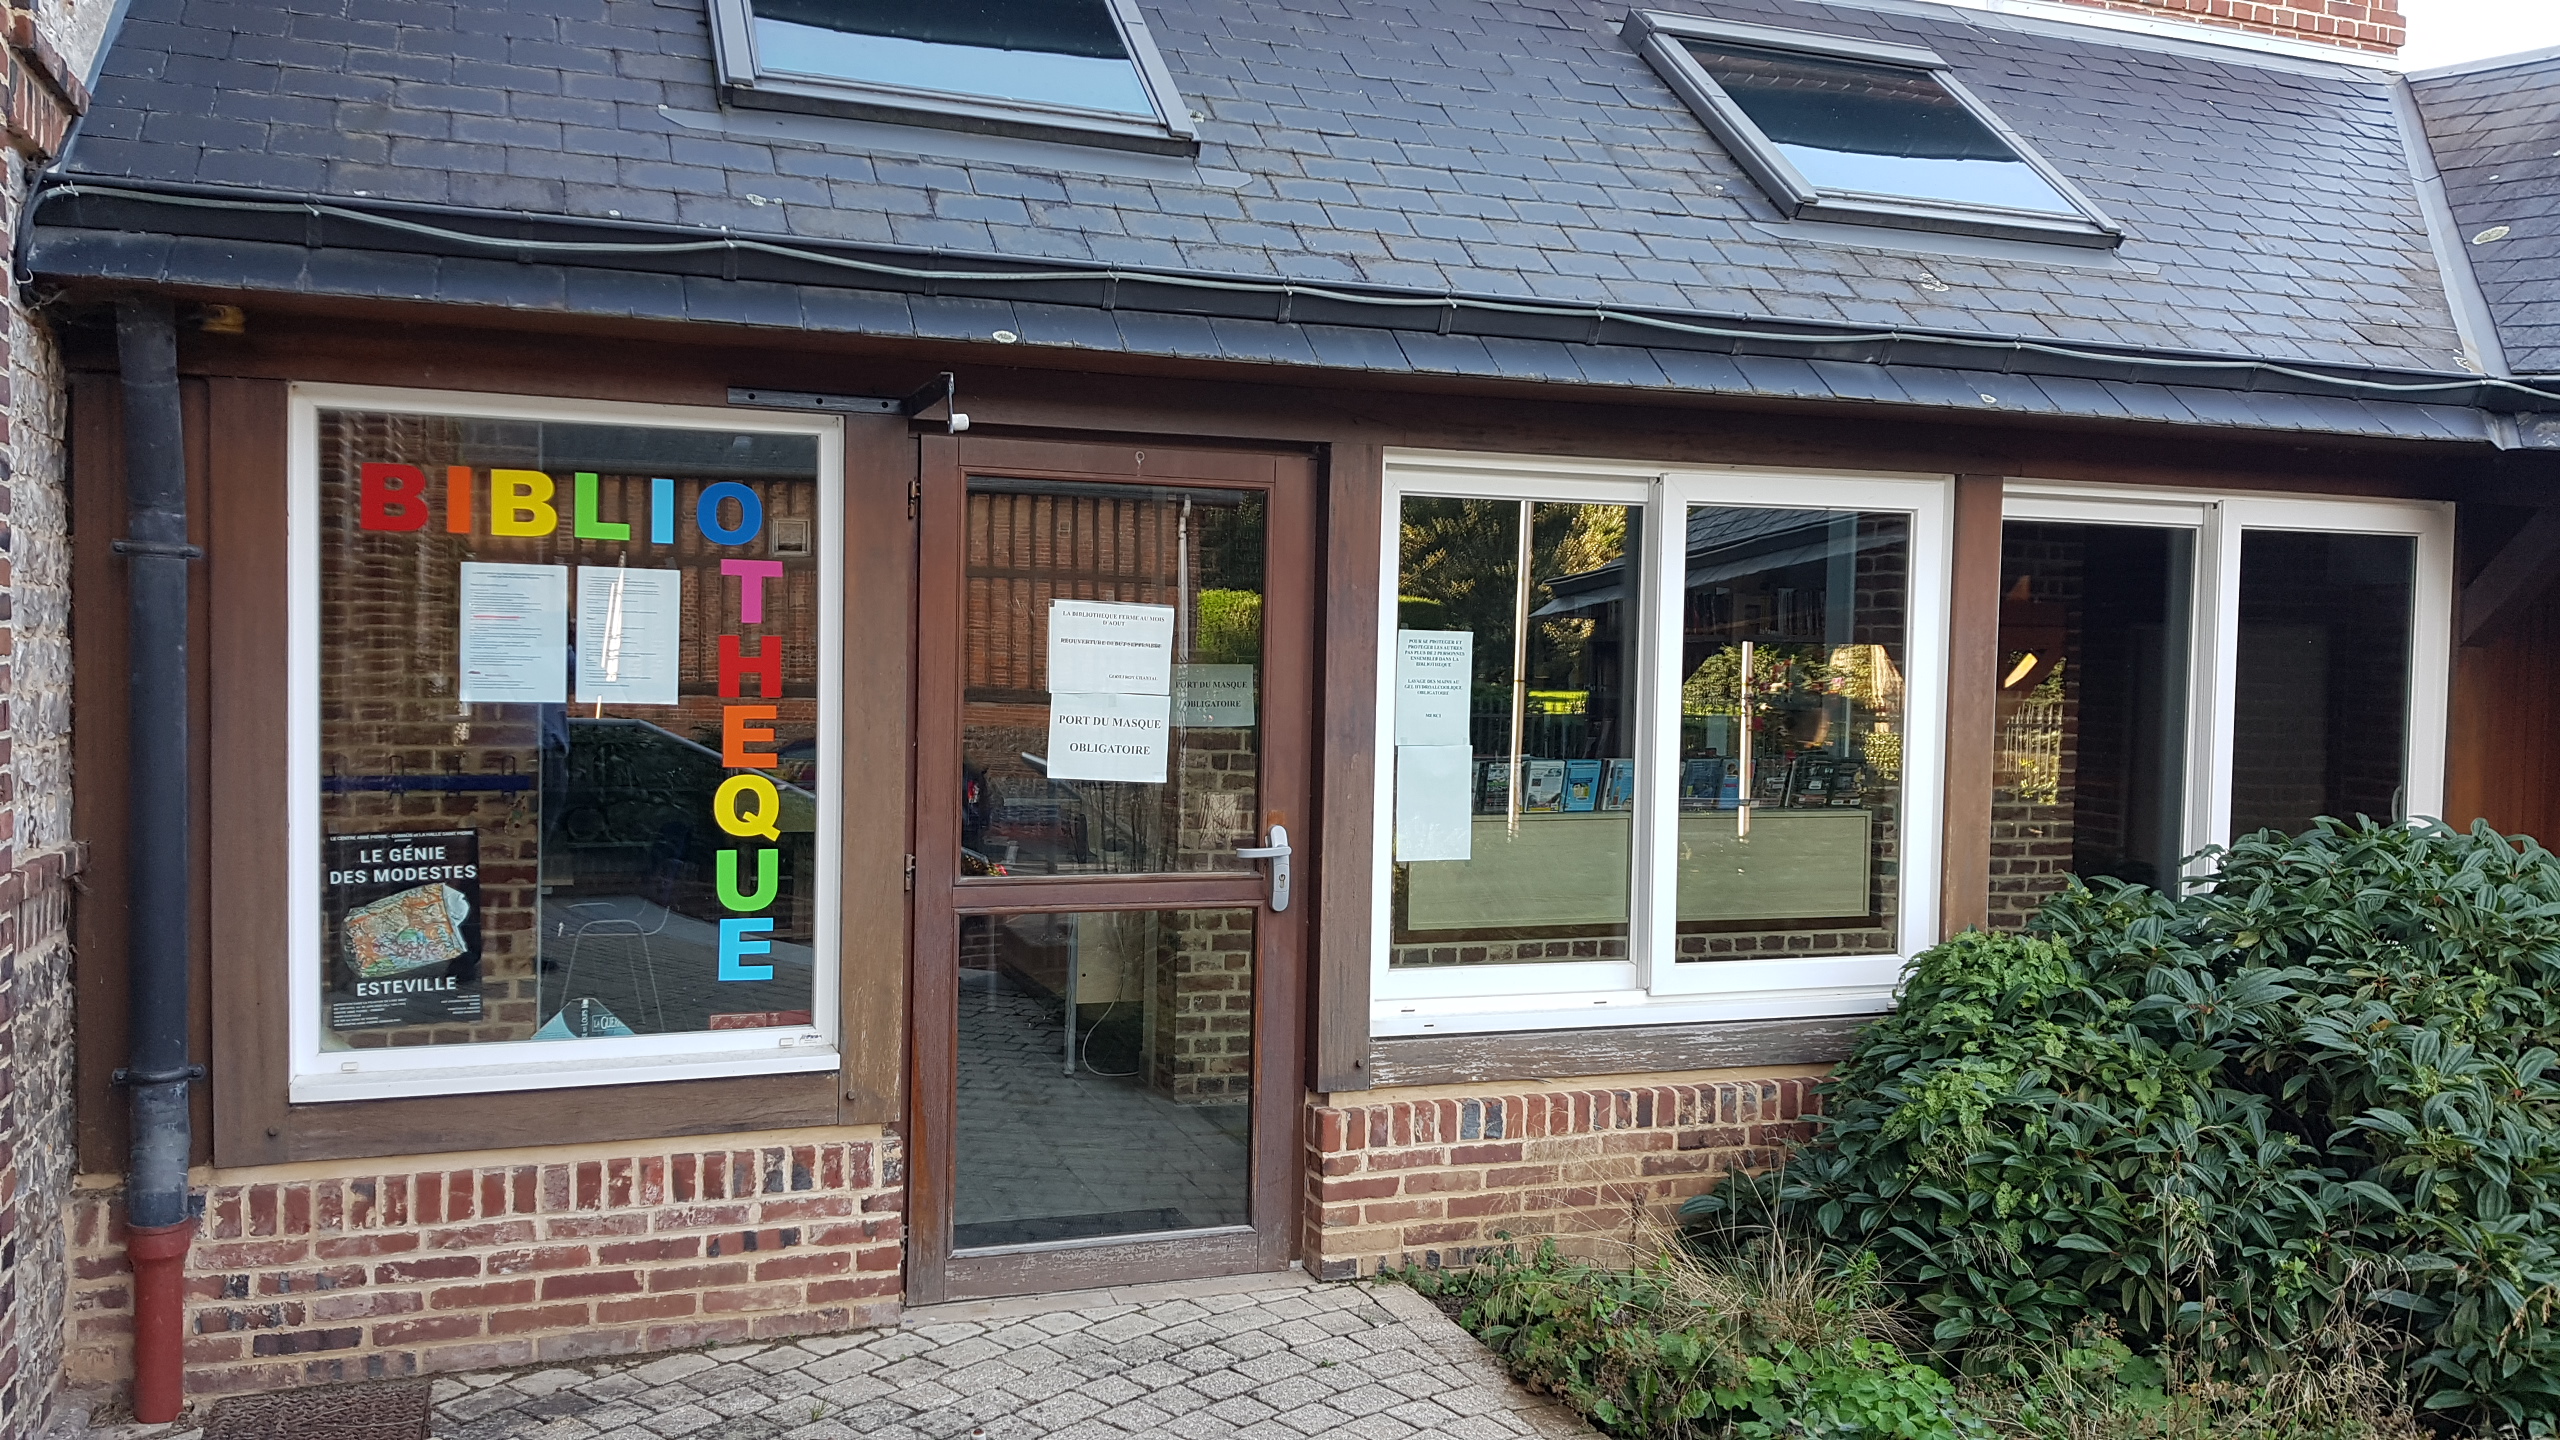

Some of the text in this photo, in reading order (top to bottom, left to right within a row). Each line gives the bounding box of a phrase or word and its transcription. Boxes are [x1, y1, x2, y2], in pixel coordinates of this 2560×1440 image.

[1199, 681, 1211, 689] DU
[1212, 681, 1248, 690] MASQUE
[1184, 700, 1242, 708] OBLIGATOIRE
[1058, 714, 1162, 731] PORT DU MASQUE
[1069, 742, 1151, 756] OBLIGATOIRE
[360, 845, 446, 864] LE GÉNIE
[329, 864, 477, 885] DES MODESTES
[356, 976, 457, 997] ESTEVILLE
